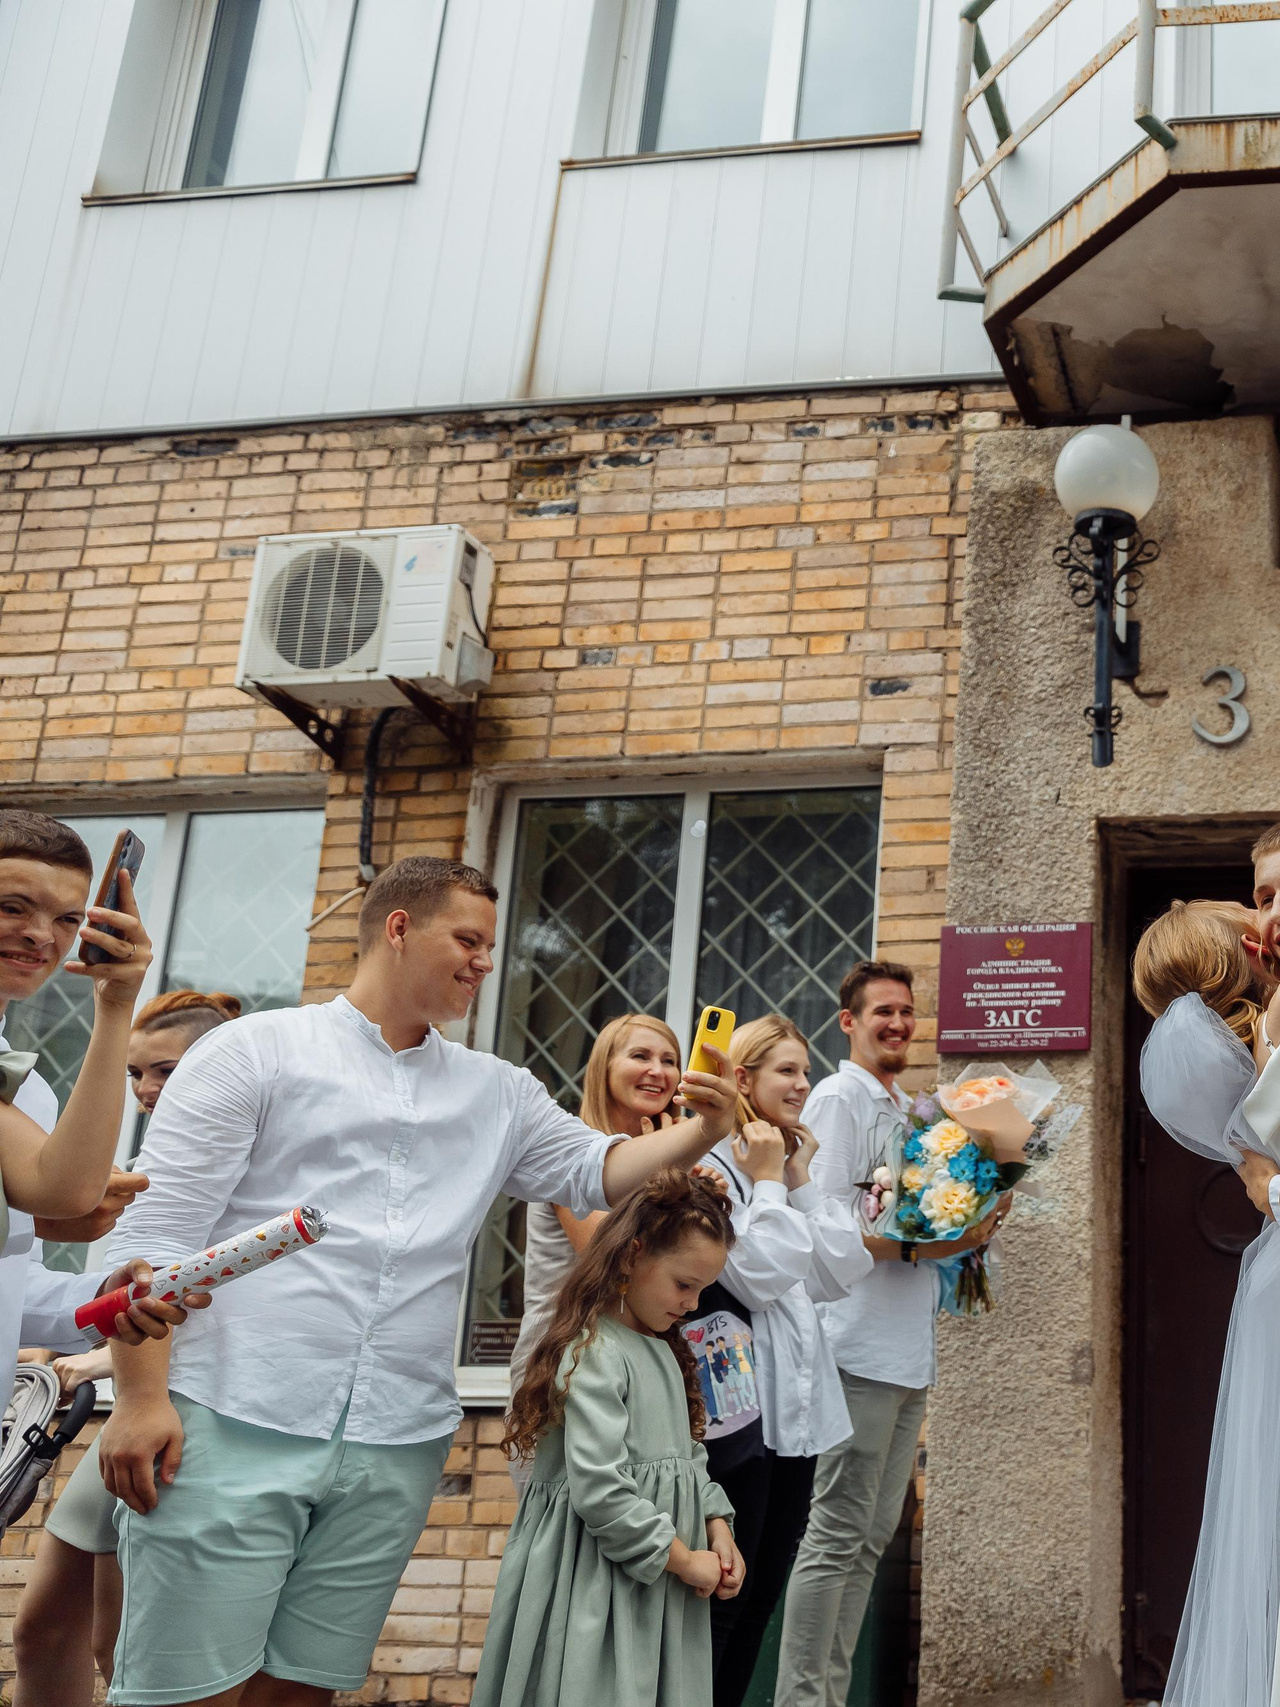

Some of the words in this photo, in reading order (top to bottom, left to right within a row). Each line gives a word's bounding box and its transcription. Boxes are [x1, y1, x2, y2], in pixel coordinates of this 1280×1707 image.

[955, 925, 1019, 935] РОССИЙСКАЯ
[1020, 923, 1077, 933] ФЕДЕРАЦИЯ
[980, 958, 1052, 967] АДМИНИСТРАЦИЯ
[966, 967, 998, 975] ГОРОДА
[998, 966, 1063, 974] ВЛАДИВОСТОКА
[984, 1009, 1042, 1028] ЗАГС
[706, 1315, 728, 1334] BTS
